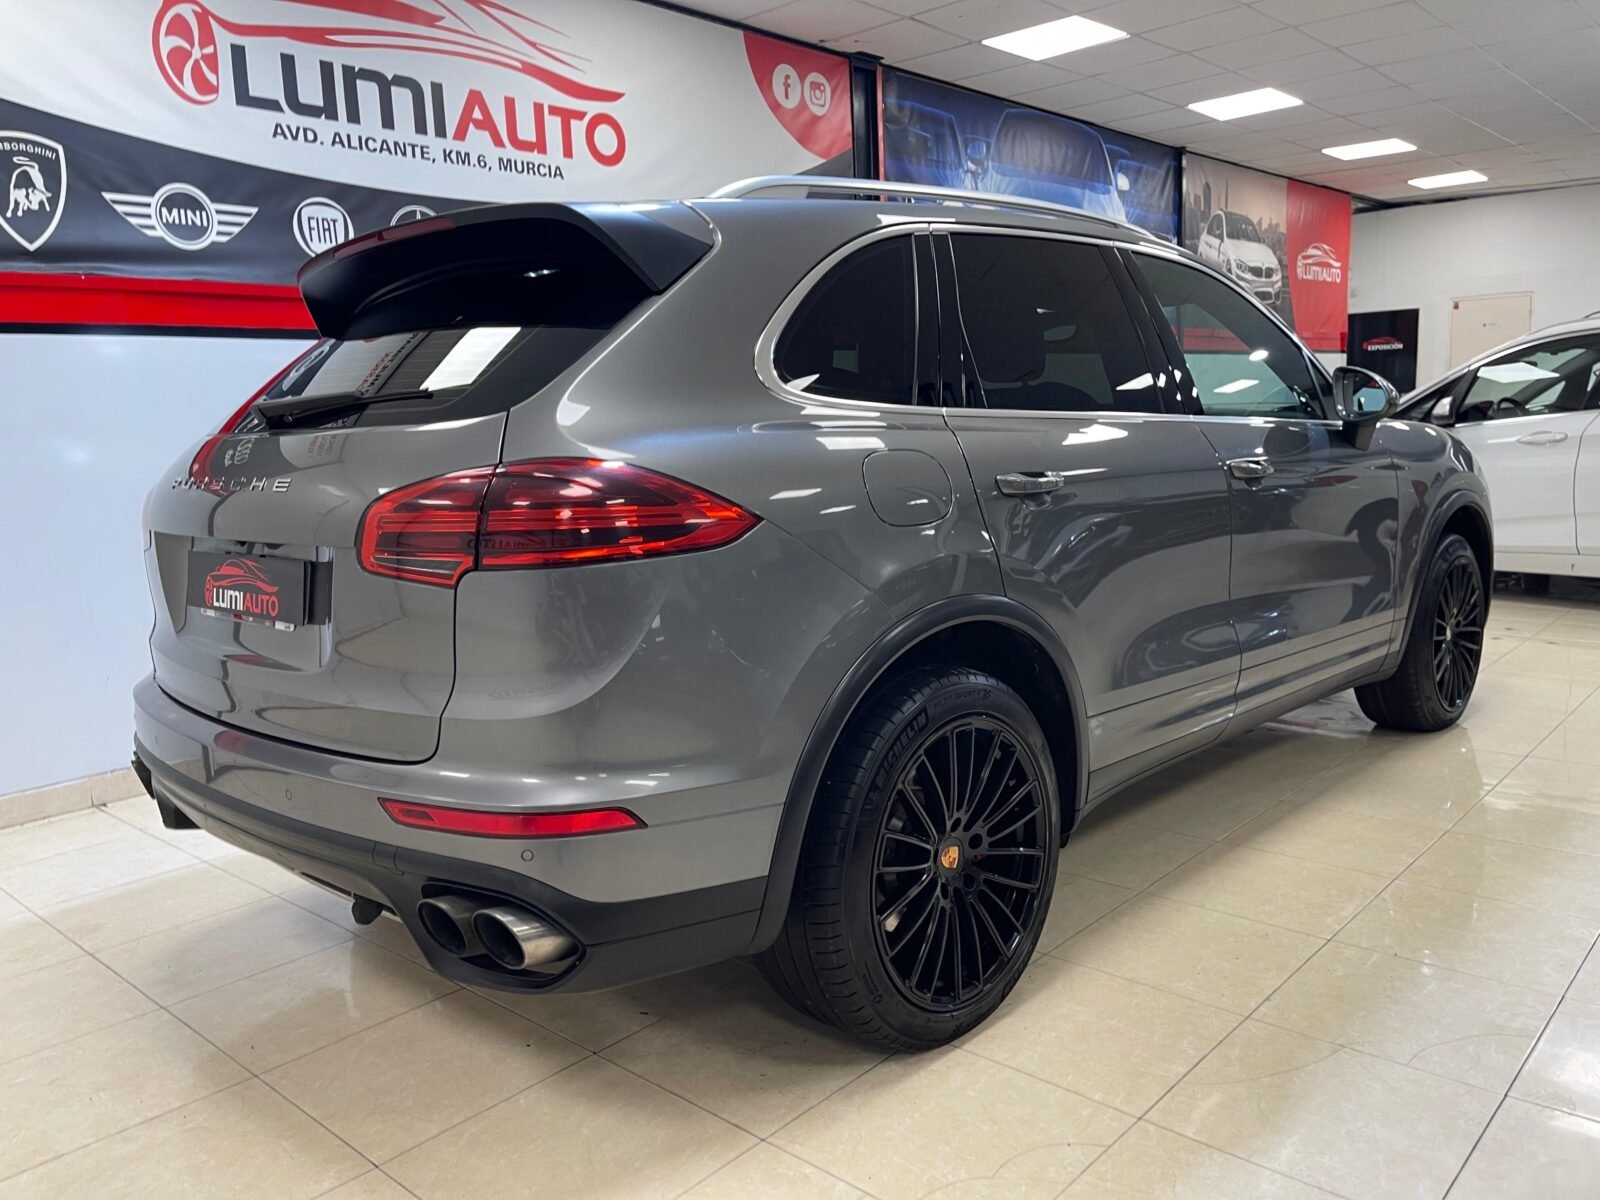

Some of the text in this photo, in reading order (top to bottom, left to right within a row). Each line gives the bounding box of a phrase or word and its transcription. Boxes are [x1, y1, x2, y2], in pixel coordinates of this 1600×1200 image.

[272, 123, 565, 180] AVD. ALICANTE, KM.6, MURCIA
[160, 206, 209, 228] MINI
[307, 215, 340, 247] FIAT
[874, 710, 928, 791] MICHELIN
